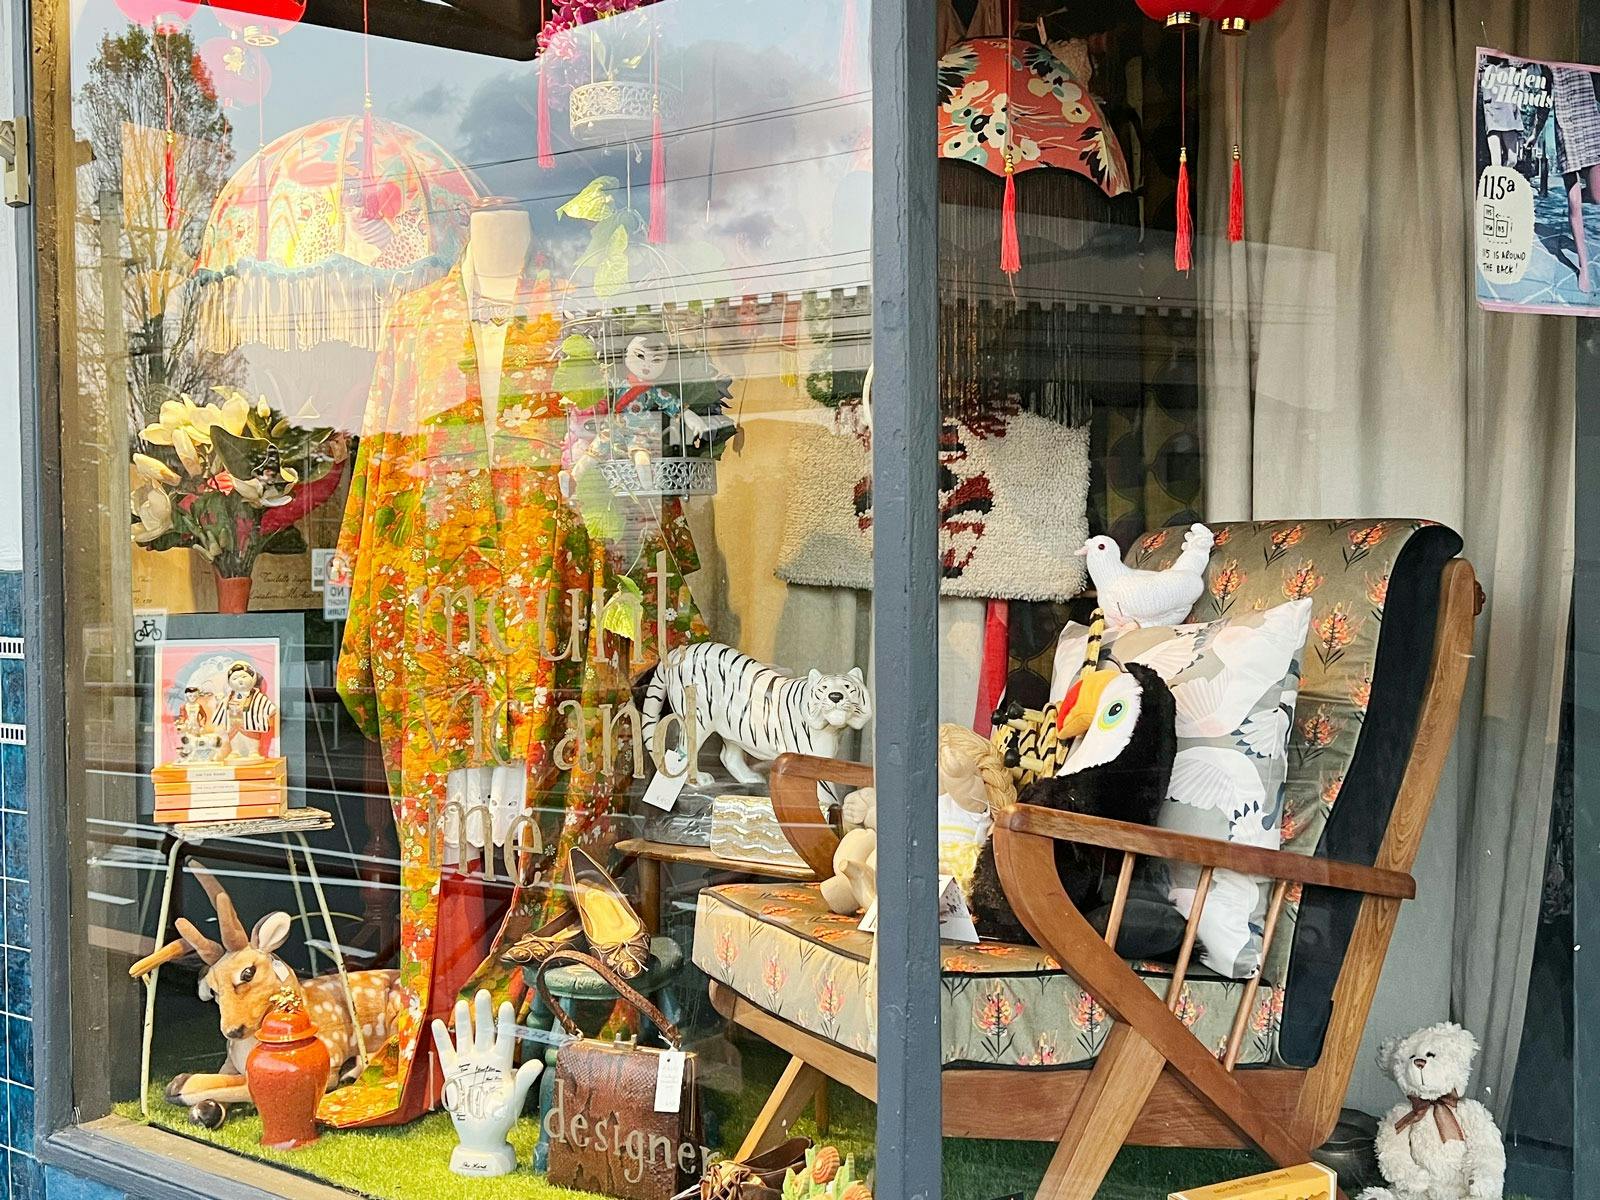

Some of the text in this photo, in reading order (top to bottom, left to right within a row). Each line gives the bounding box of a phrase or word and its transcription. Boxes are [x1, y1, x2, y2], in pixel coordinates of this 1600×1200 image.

[1482, 262, 1493, 272] THE
[1493, 251, 1499, 260] IS
[1501, 250, 1526, 261] AROUND
[553, 685, 698, 787] and
[543, 1078, 721, 1184] designer
